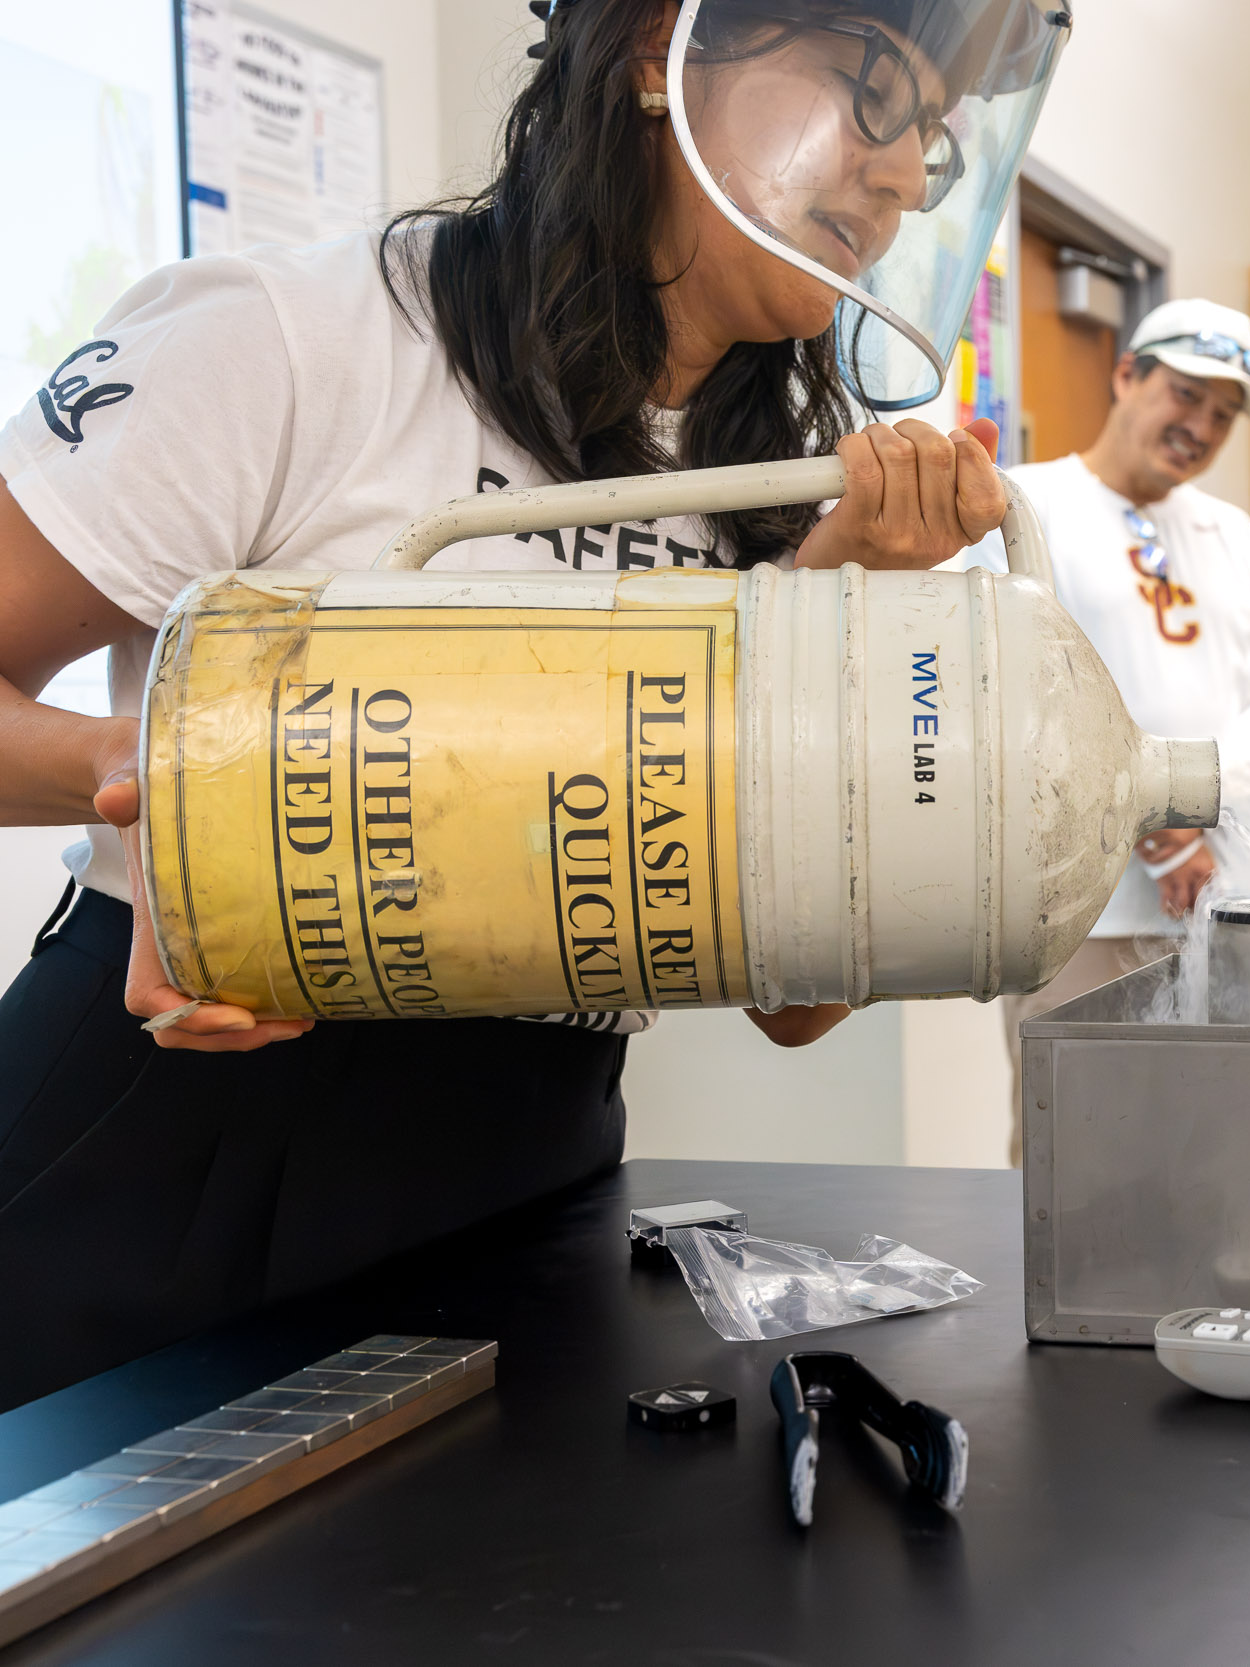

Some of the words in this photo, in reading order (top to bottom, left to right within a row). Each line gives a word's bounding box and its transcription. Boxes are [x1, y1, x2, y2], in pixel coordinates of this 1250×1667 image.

[37, 340, 134, 443] Cal
[912, 653, 938, 736] MVE
[283, 678, 334, 856] NEED
[363, 687, 418, 917] OTHER
[637, 671, 691, 909] PLEASE
[914, 743, 936, 783] LAB
[915, 792, 936, 804] 4
[290, 874, 357, 988] THIS
[376, 931, 446, 1016] PEOP
